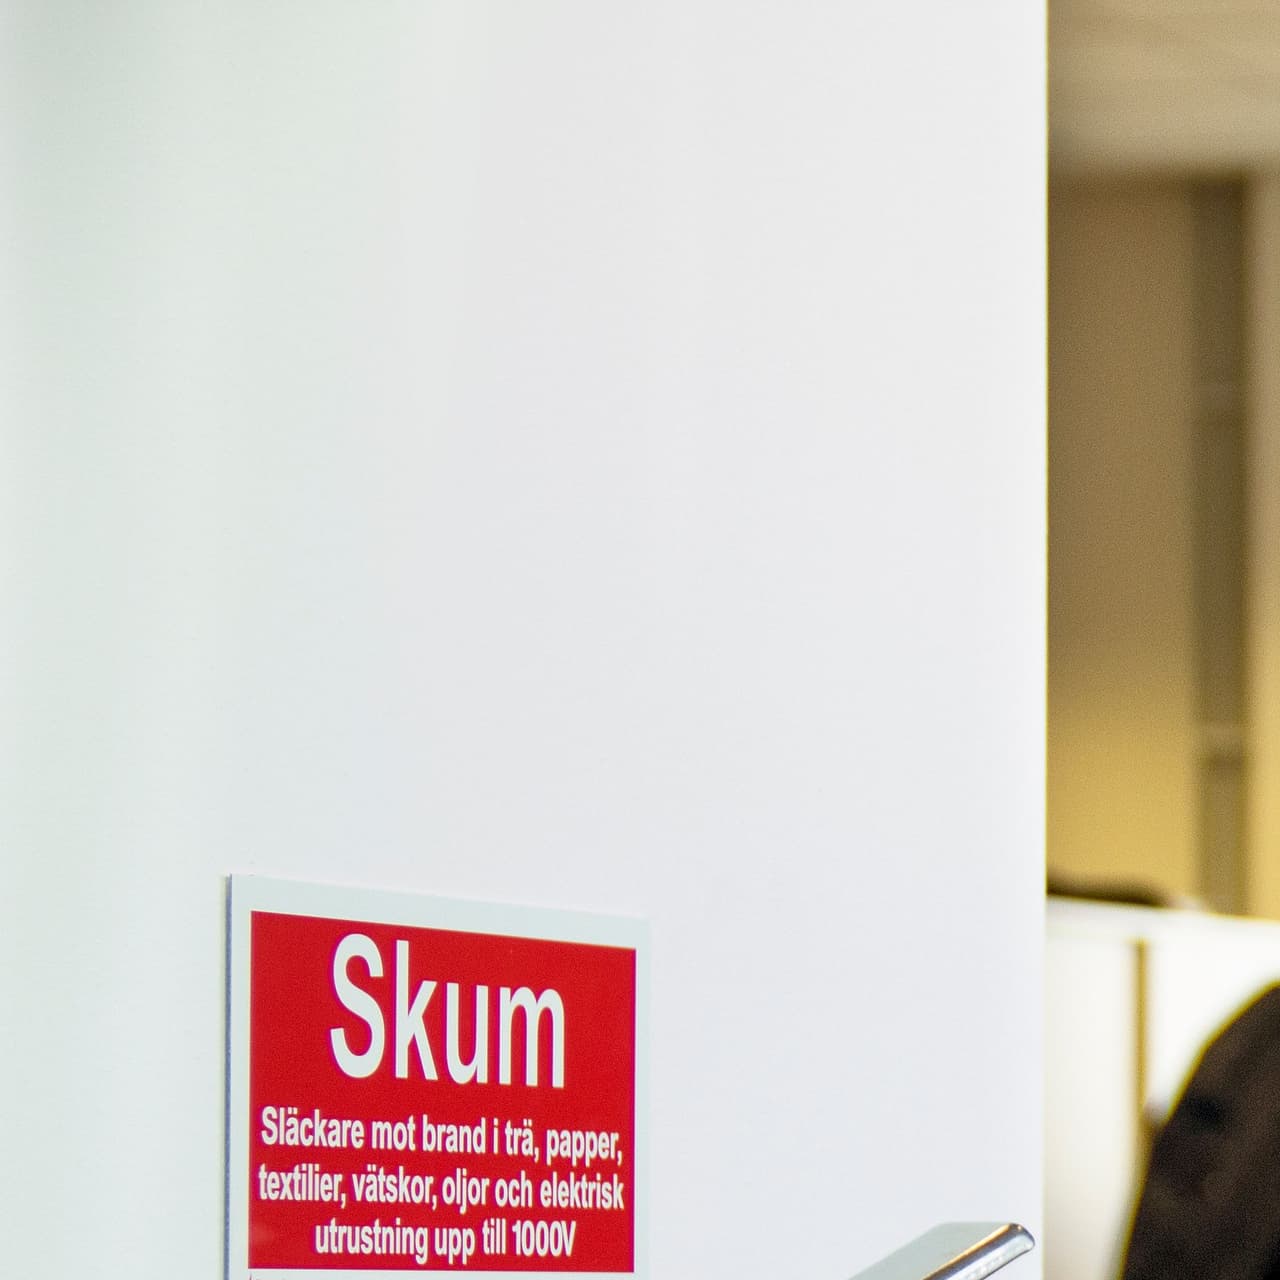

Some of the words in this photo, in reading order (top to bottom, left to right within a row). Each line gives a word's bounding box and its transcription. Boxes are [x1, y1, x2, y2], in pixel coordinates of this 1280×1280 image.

[330, 933, 566, 1089] Skum
[261, 1105, 364, 1148] Släckare
[371, 1114, 416, 1152] mot
[422, 1114, 486, 1154] brand
[492, 1118, 499, 1155] i
[505, 1118, 540, 1162] trä,
[545, 1129, 623, 1167] papper,
[258, 1163, 347, 1209] textilier,
[352, 1164, 438, 1211] vätskor,
[442, 1168, 490, 1214] oljor
[494, 1170, 532, 1209] och
[540, 1172, 625, 1210] elektrisk
[315, 1217, 429, 1265] utrustning
[434, 1227, 475, 1265] upp
[482, 1218, 507, 1256] till
[512, 1220, 577, 1258] 1000V
